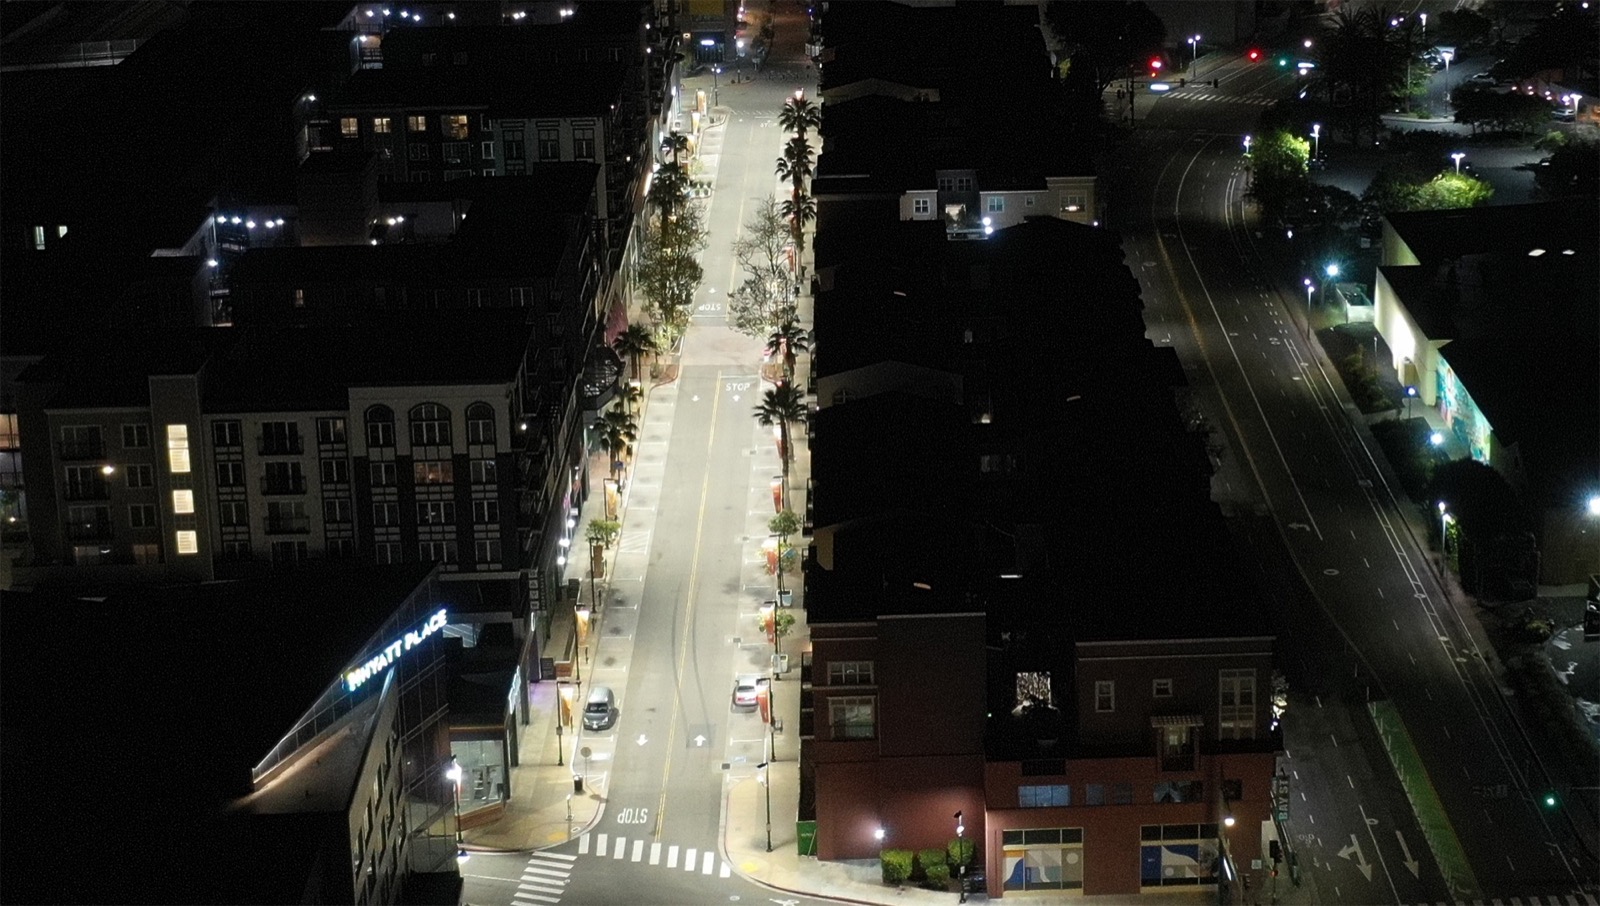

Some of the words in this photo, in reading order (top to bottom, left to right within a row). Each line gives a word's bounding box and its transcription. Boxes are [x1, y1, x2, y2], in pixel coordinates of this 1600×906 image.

[698, 303, 721, 311] STOP
[725, 382, 750, 391] STOP
[358, 640, 402, 683] HYATT
[404, 609, 448, 650] PLACE
[617, 807, 649, 824] STOP
[1279, 797, 1289, 820] BAY
